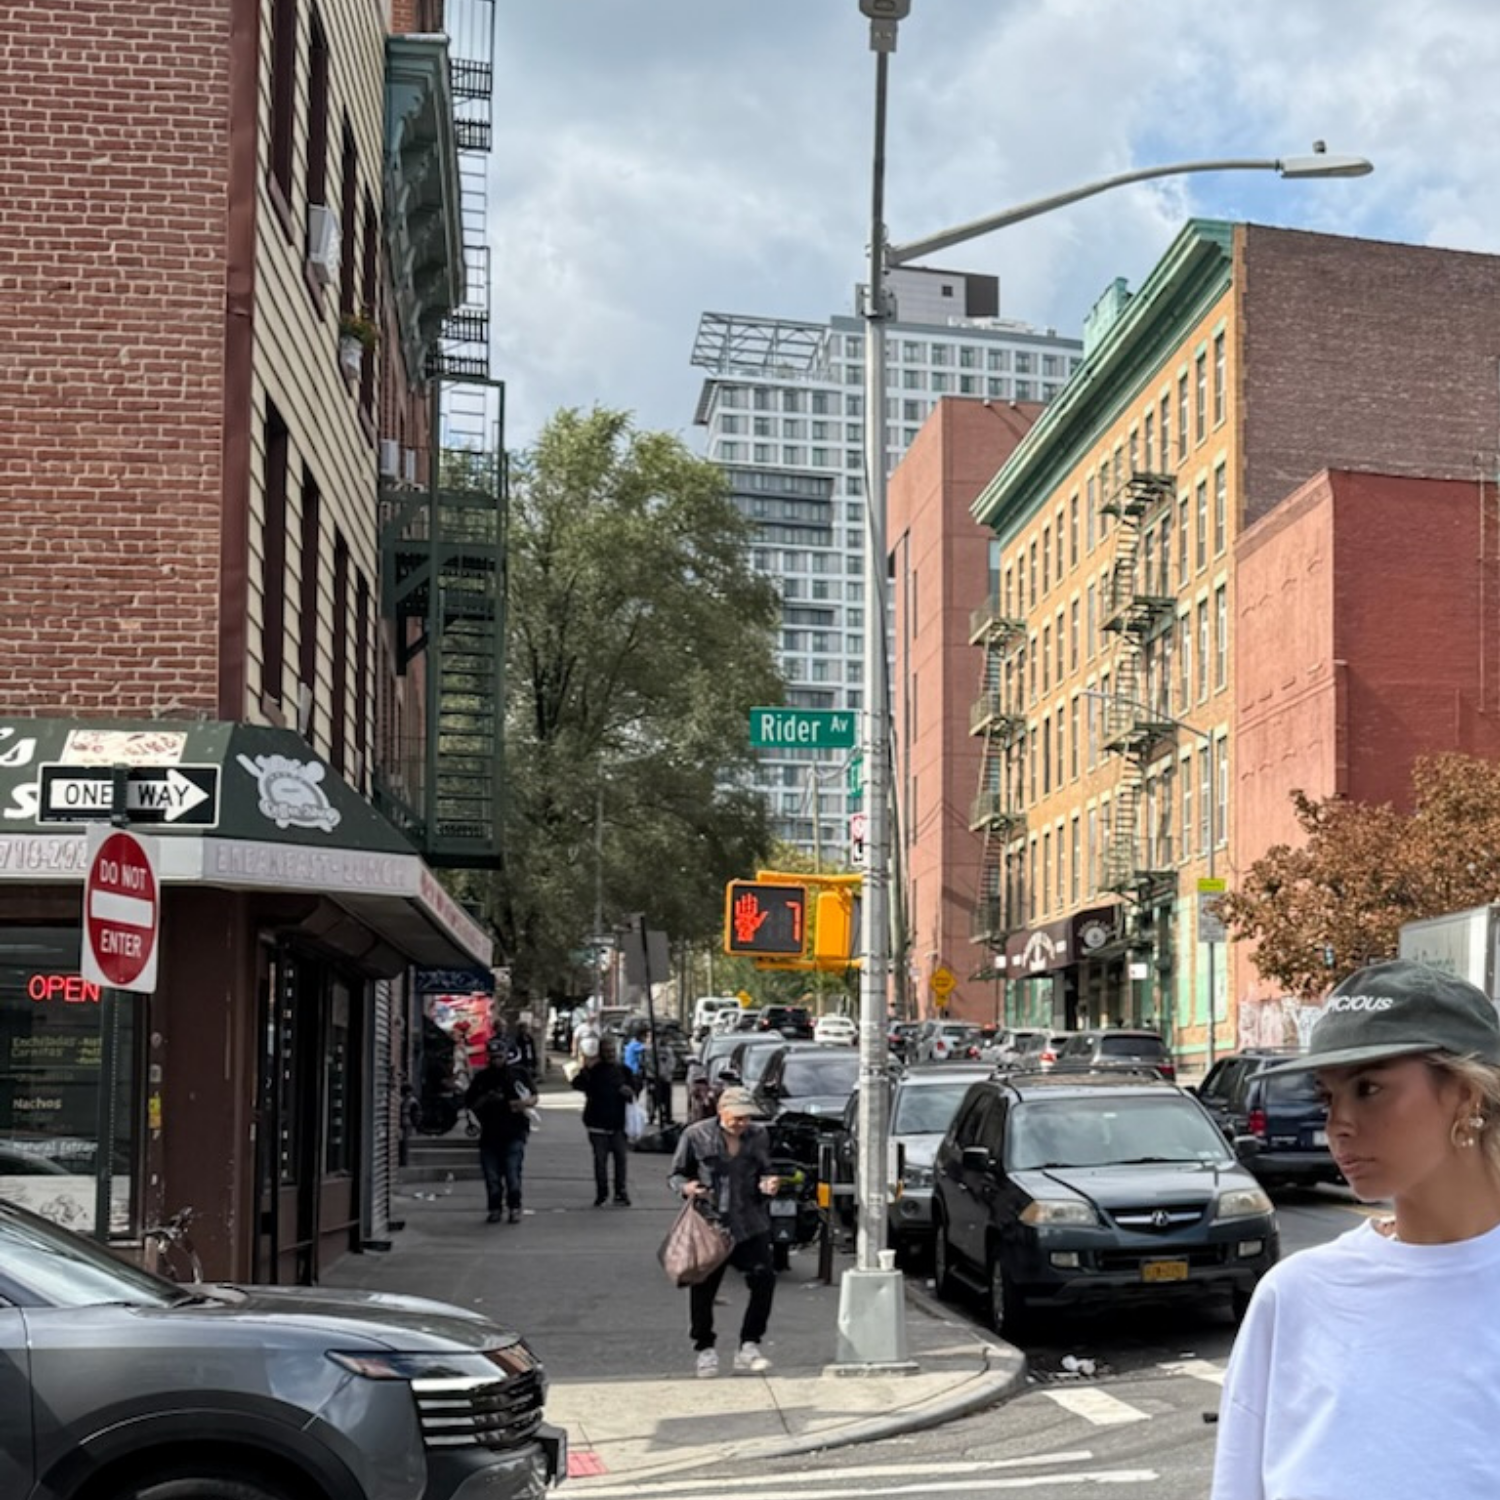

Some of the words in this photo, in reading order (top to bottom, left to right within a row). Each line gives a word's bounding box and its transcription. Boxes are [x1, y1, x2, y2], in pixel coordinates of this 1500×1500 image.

[760, 714, 821, 742] Rider
[830, 716, 848, 732] Av
[64, 784, 114, 805] ONE
[138, 784, 190, 806] WAY
[100, 860, 118, 885] DO
[122, 864, 147, 891] NOT
[101, 929, 142, 958] ENTER
[28, 975, 101, 1002] OPEN
[13, 1097, 62, 1109] Nachos
